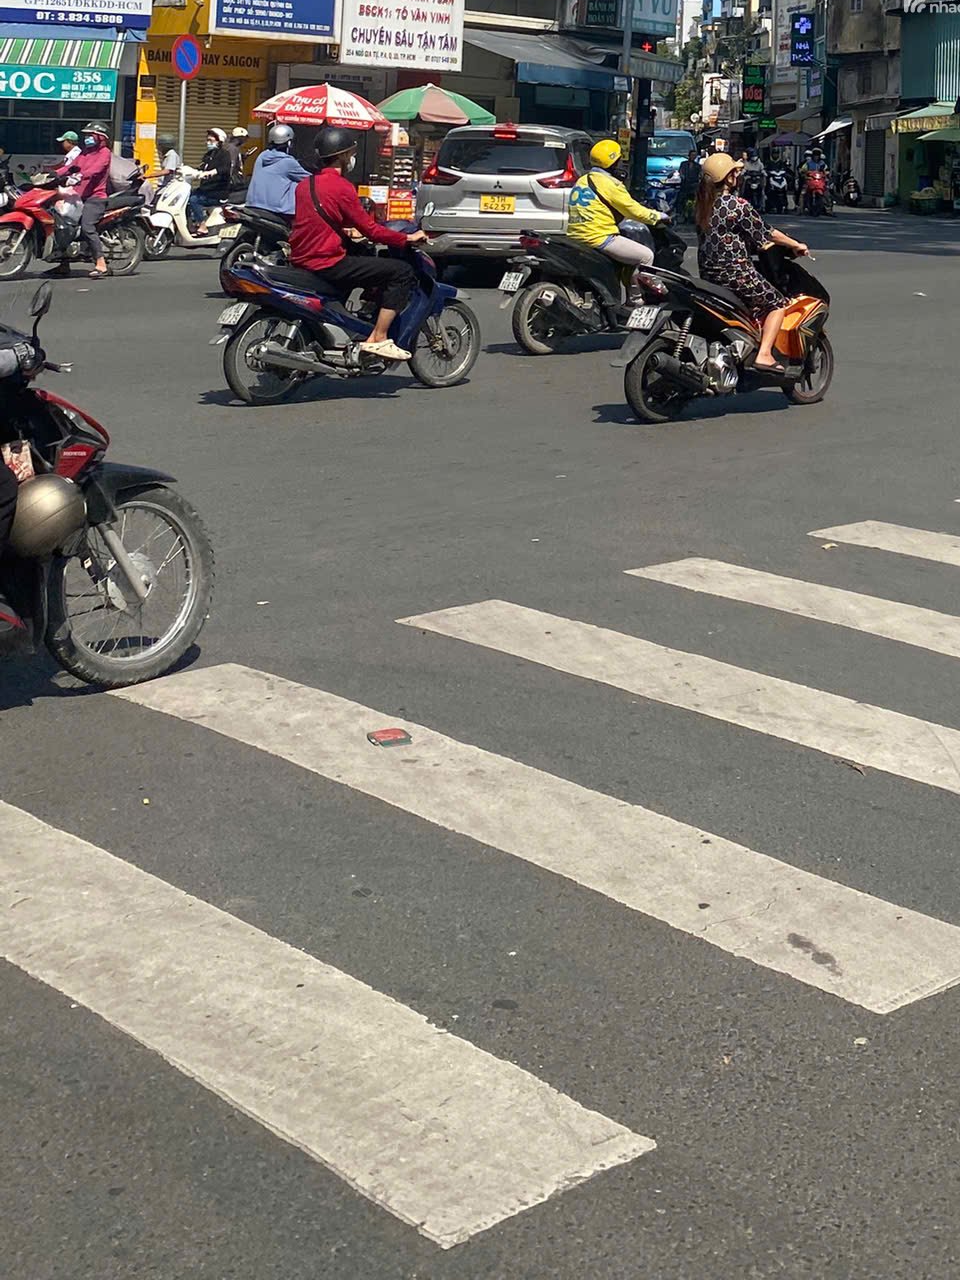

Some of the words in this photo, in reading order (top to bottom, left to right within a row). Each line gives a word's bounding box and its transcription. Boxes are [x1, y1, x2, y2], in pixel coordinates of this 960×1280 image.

[351, 25, 392, 45] CHUYÊN
[148, 48, 172, 62] BÁN
[223, 55, 260, 68] SAIGON
[73, 70, 102, 83] 358
